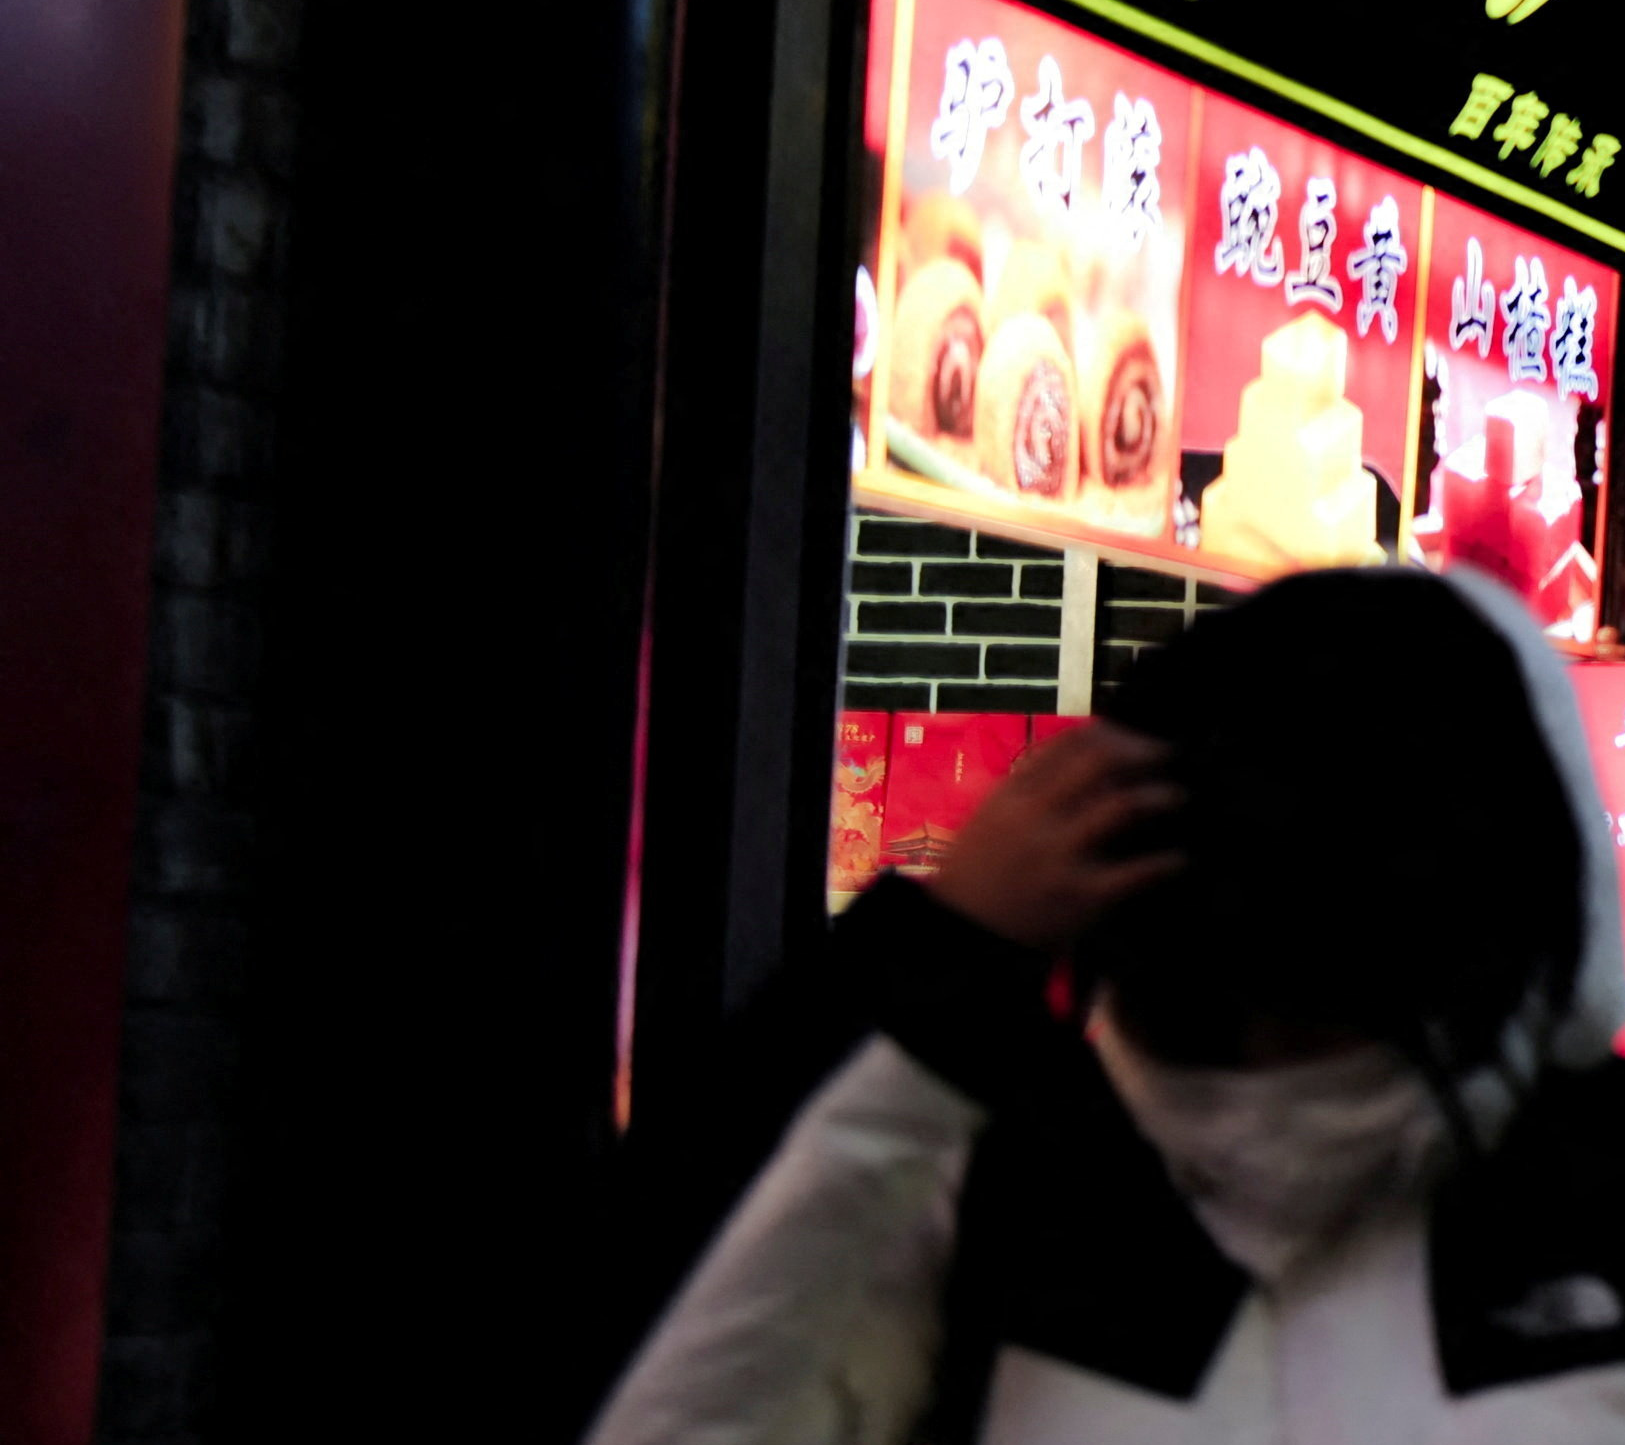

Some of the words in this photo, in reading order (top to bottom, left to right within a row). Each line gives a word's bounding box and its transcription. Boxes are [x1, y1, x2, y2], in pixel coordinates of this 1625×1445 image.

[930, 35, 1165, 244] 驴打滚
[1213, 144, 1409, 344] 豌豆黄
[1450, 235, 1599, 404] 山楂糕
